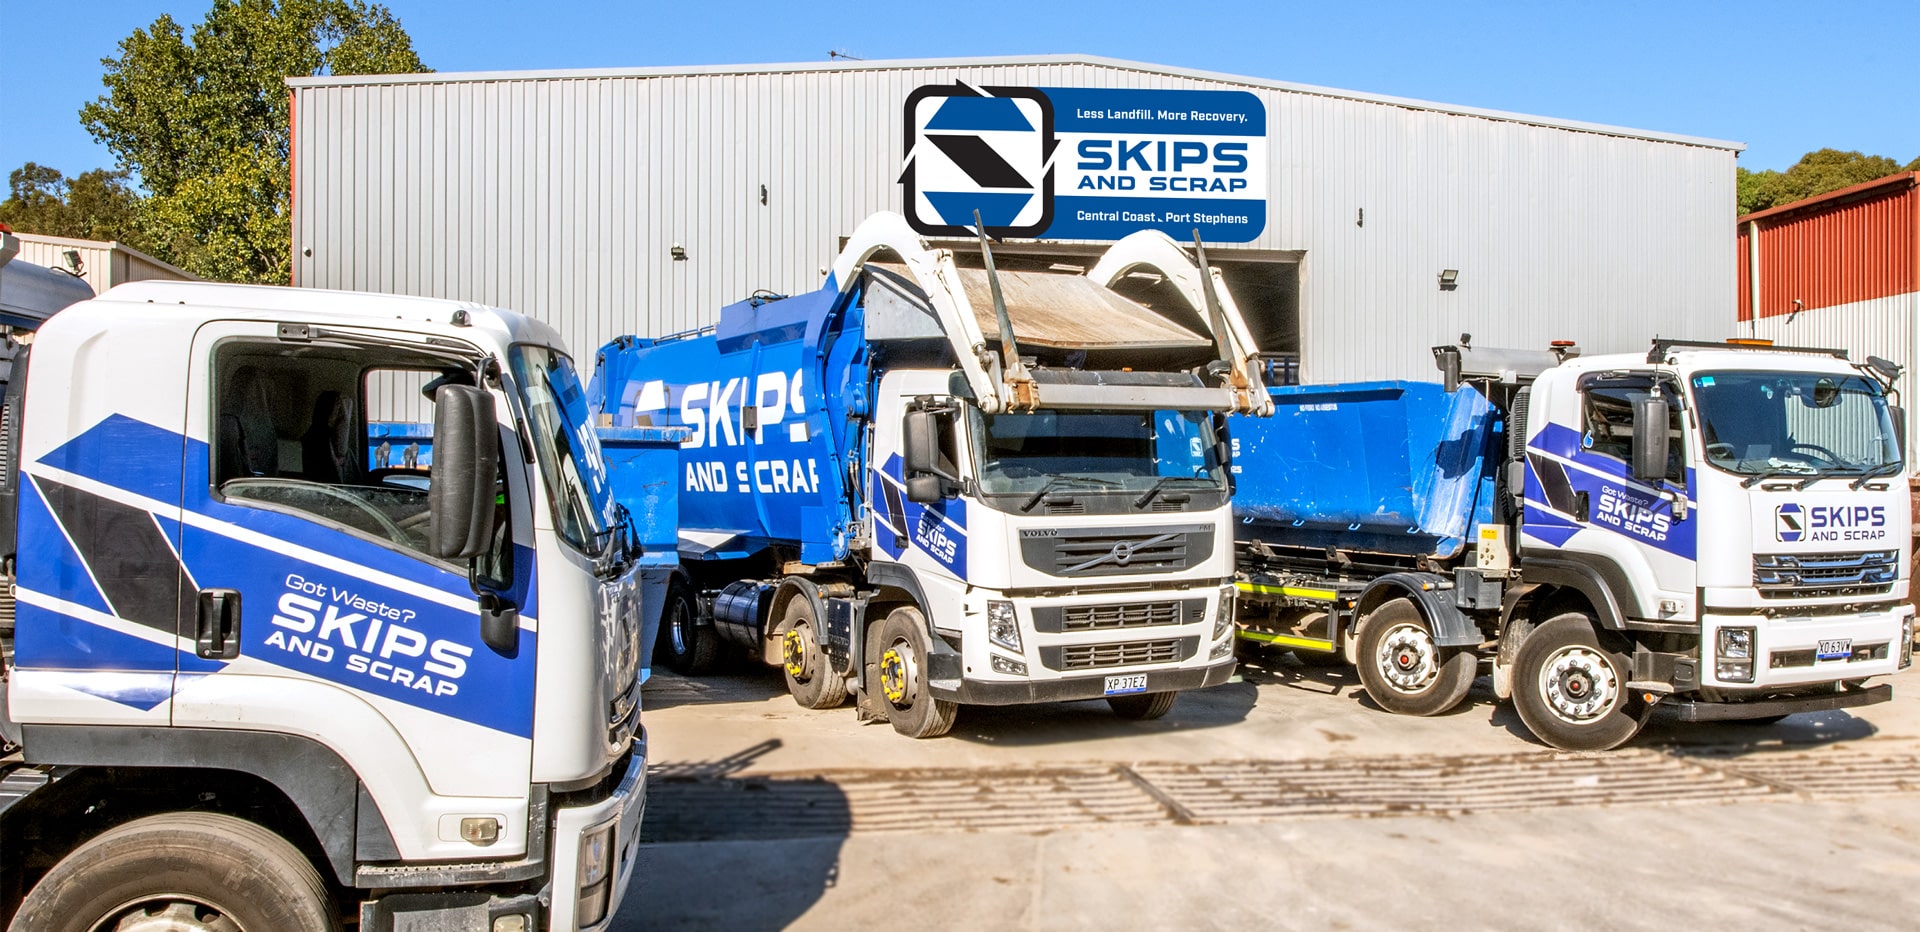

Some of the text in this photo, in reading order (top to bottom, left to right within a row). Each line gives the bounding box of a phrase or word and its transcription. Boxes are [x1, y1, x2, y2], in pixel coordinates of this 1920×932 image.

[1077, 109, 1248, 124] Less Landfill. More Recovery.
[1077, 139, 1248, 173] SKIPS
[1077, 175, 1247, 192] AND SCRAP
[1077, 210, 1248, 225] Central Coast Port Stephens
[686, 461, 728, 492] AND
[1602, 486, 1648, 506] Got Waste?
[1597, 511, 1666, 541] AND SCRAP
[1598, 494, 1671, 532] SKIPS
[1811, 506, 1885, 527] SKIPS
[916, 534, 954, 564] AND SCRAP
[917, 519, 957, 557] SKIPS
[1811, 530, 1885, 541] AND SCRAP
[285, 573, 416, 623] Got Waste?
[271, 592, 473, 679] SKIPS
[264, 630, 459, 697] AND SCRAP
[1107, 676, 1145, 690] XP 37EZ
